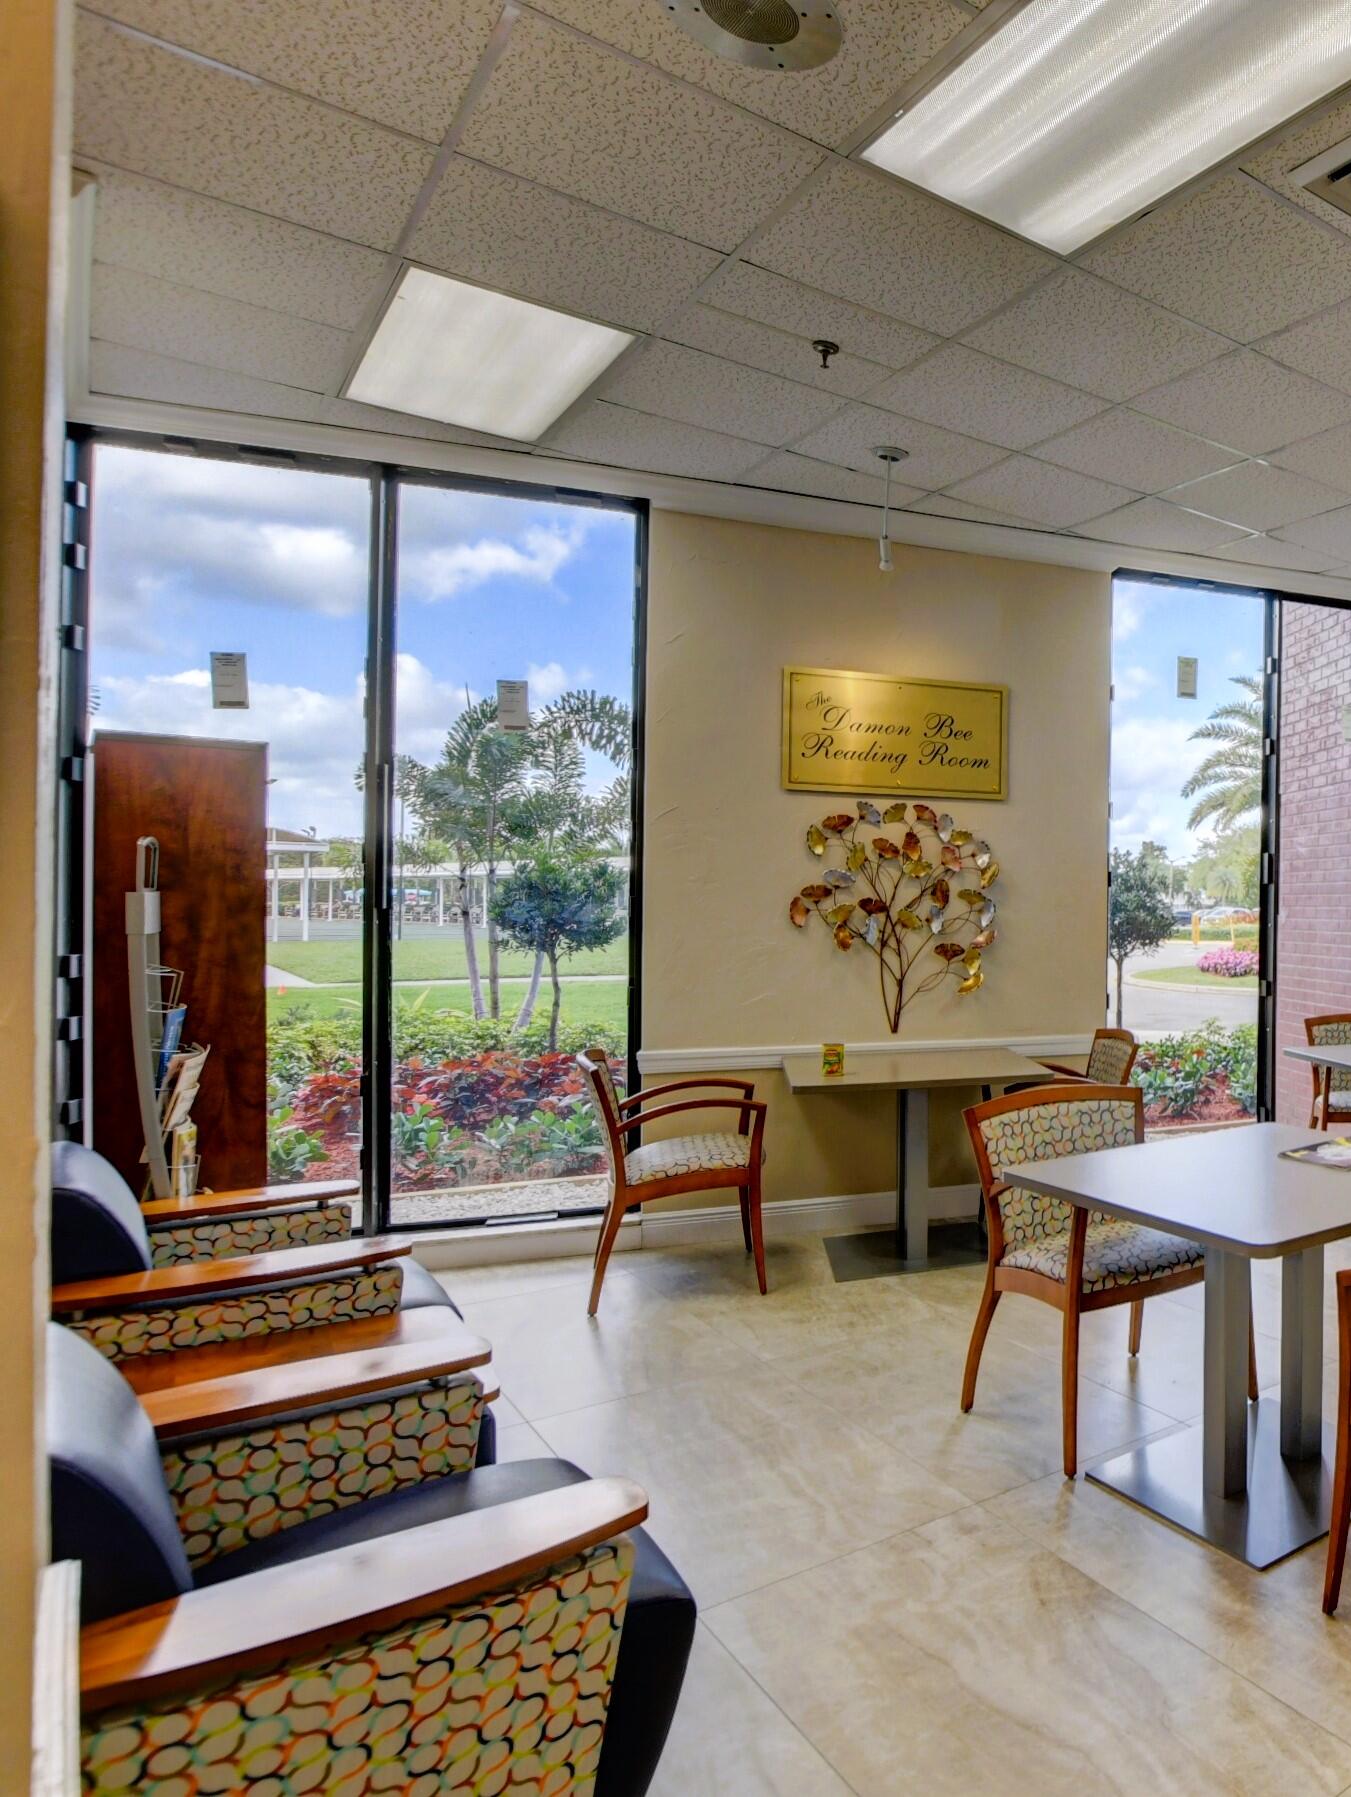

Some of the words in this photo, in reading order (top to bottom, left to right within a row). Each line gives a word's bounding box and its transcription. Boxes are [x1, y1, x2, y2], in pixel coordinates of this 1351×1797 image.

[806, 691, 832, 711] The
[820, 704, 913, 737] Damon
[923, 712, 975, 742] Bee
[801, 732, 908, 774] Reading
[919, 741, 991, 770] Room
